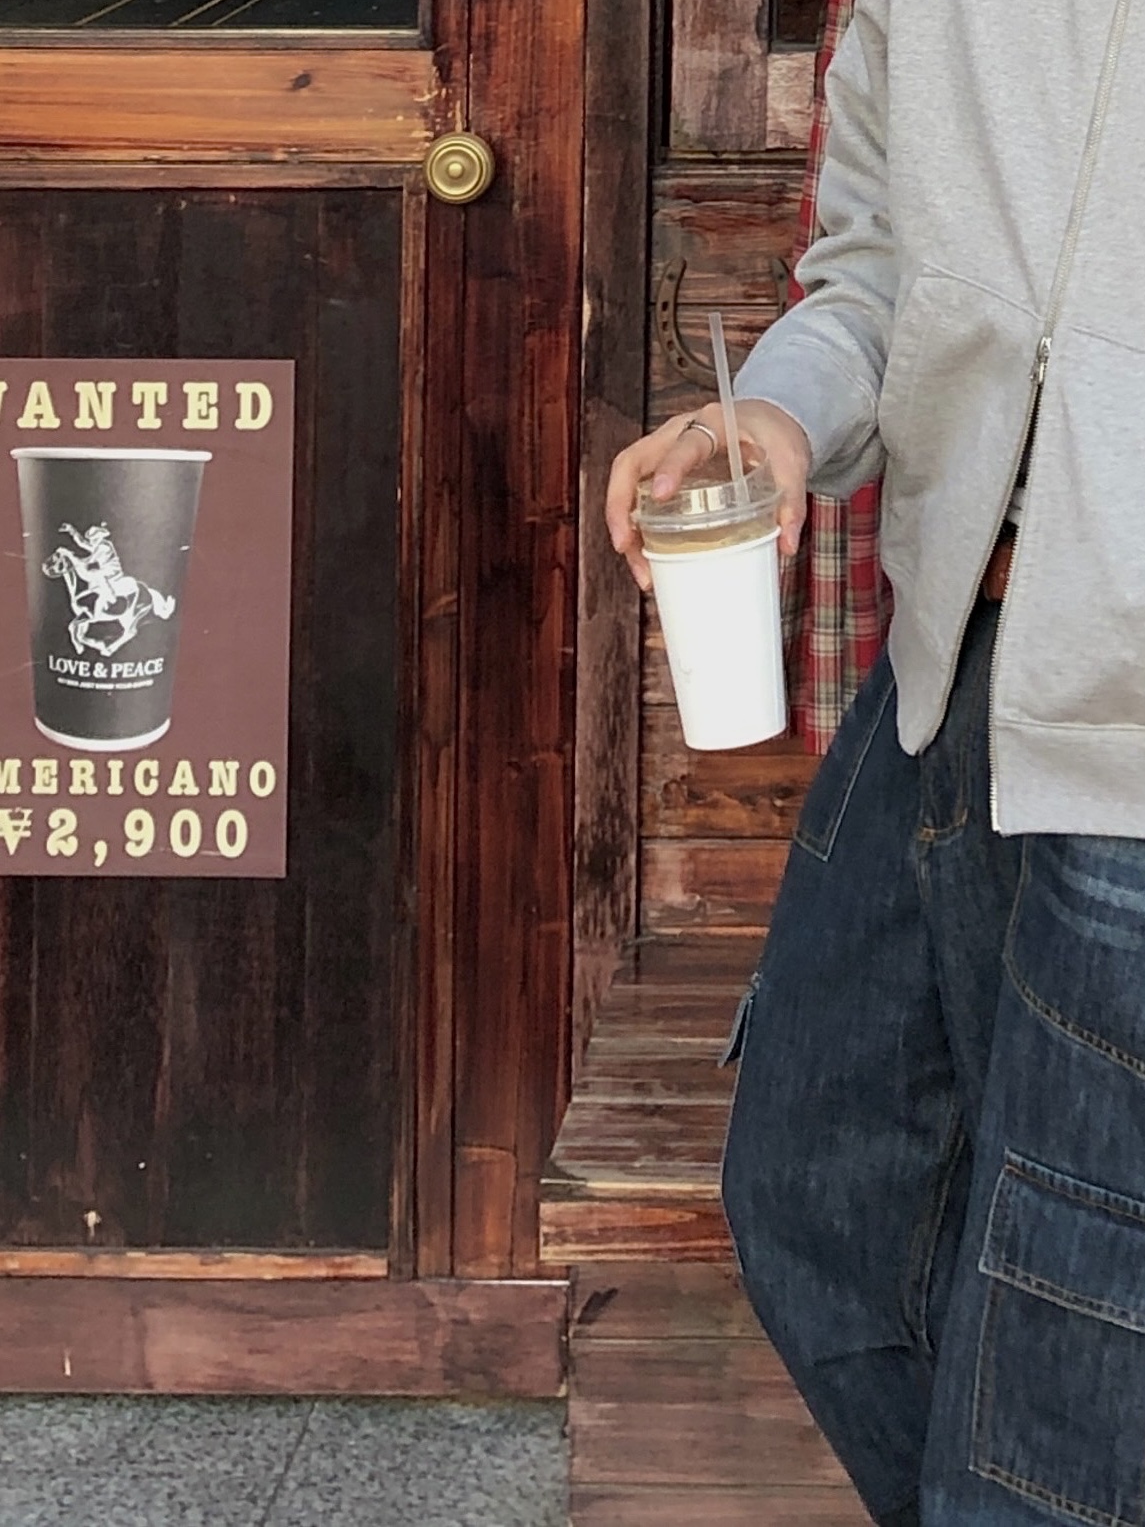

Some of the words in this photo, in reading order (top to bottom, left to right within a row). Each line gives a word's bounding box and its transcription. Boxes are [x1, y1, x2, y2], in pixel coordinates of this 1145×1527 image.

[0, 380, 273, 431] ANTED
[48, 655, 91, 677] LOVE
[93, 662, 108, 679] &
[110, 657, 164, 679] PEACE
